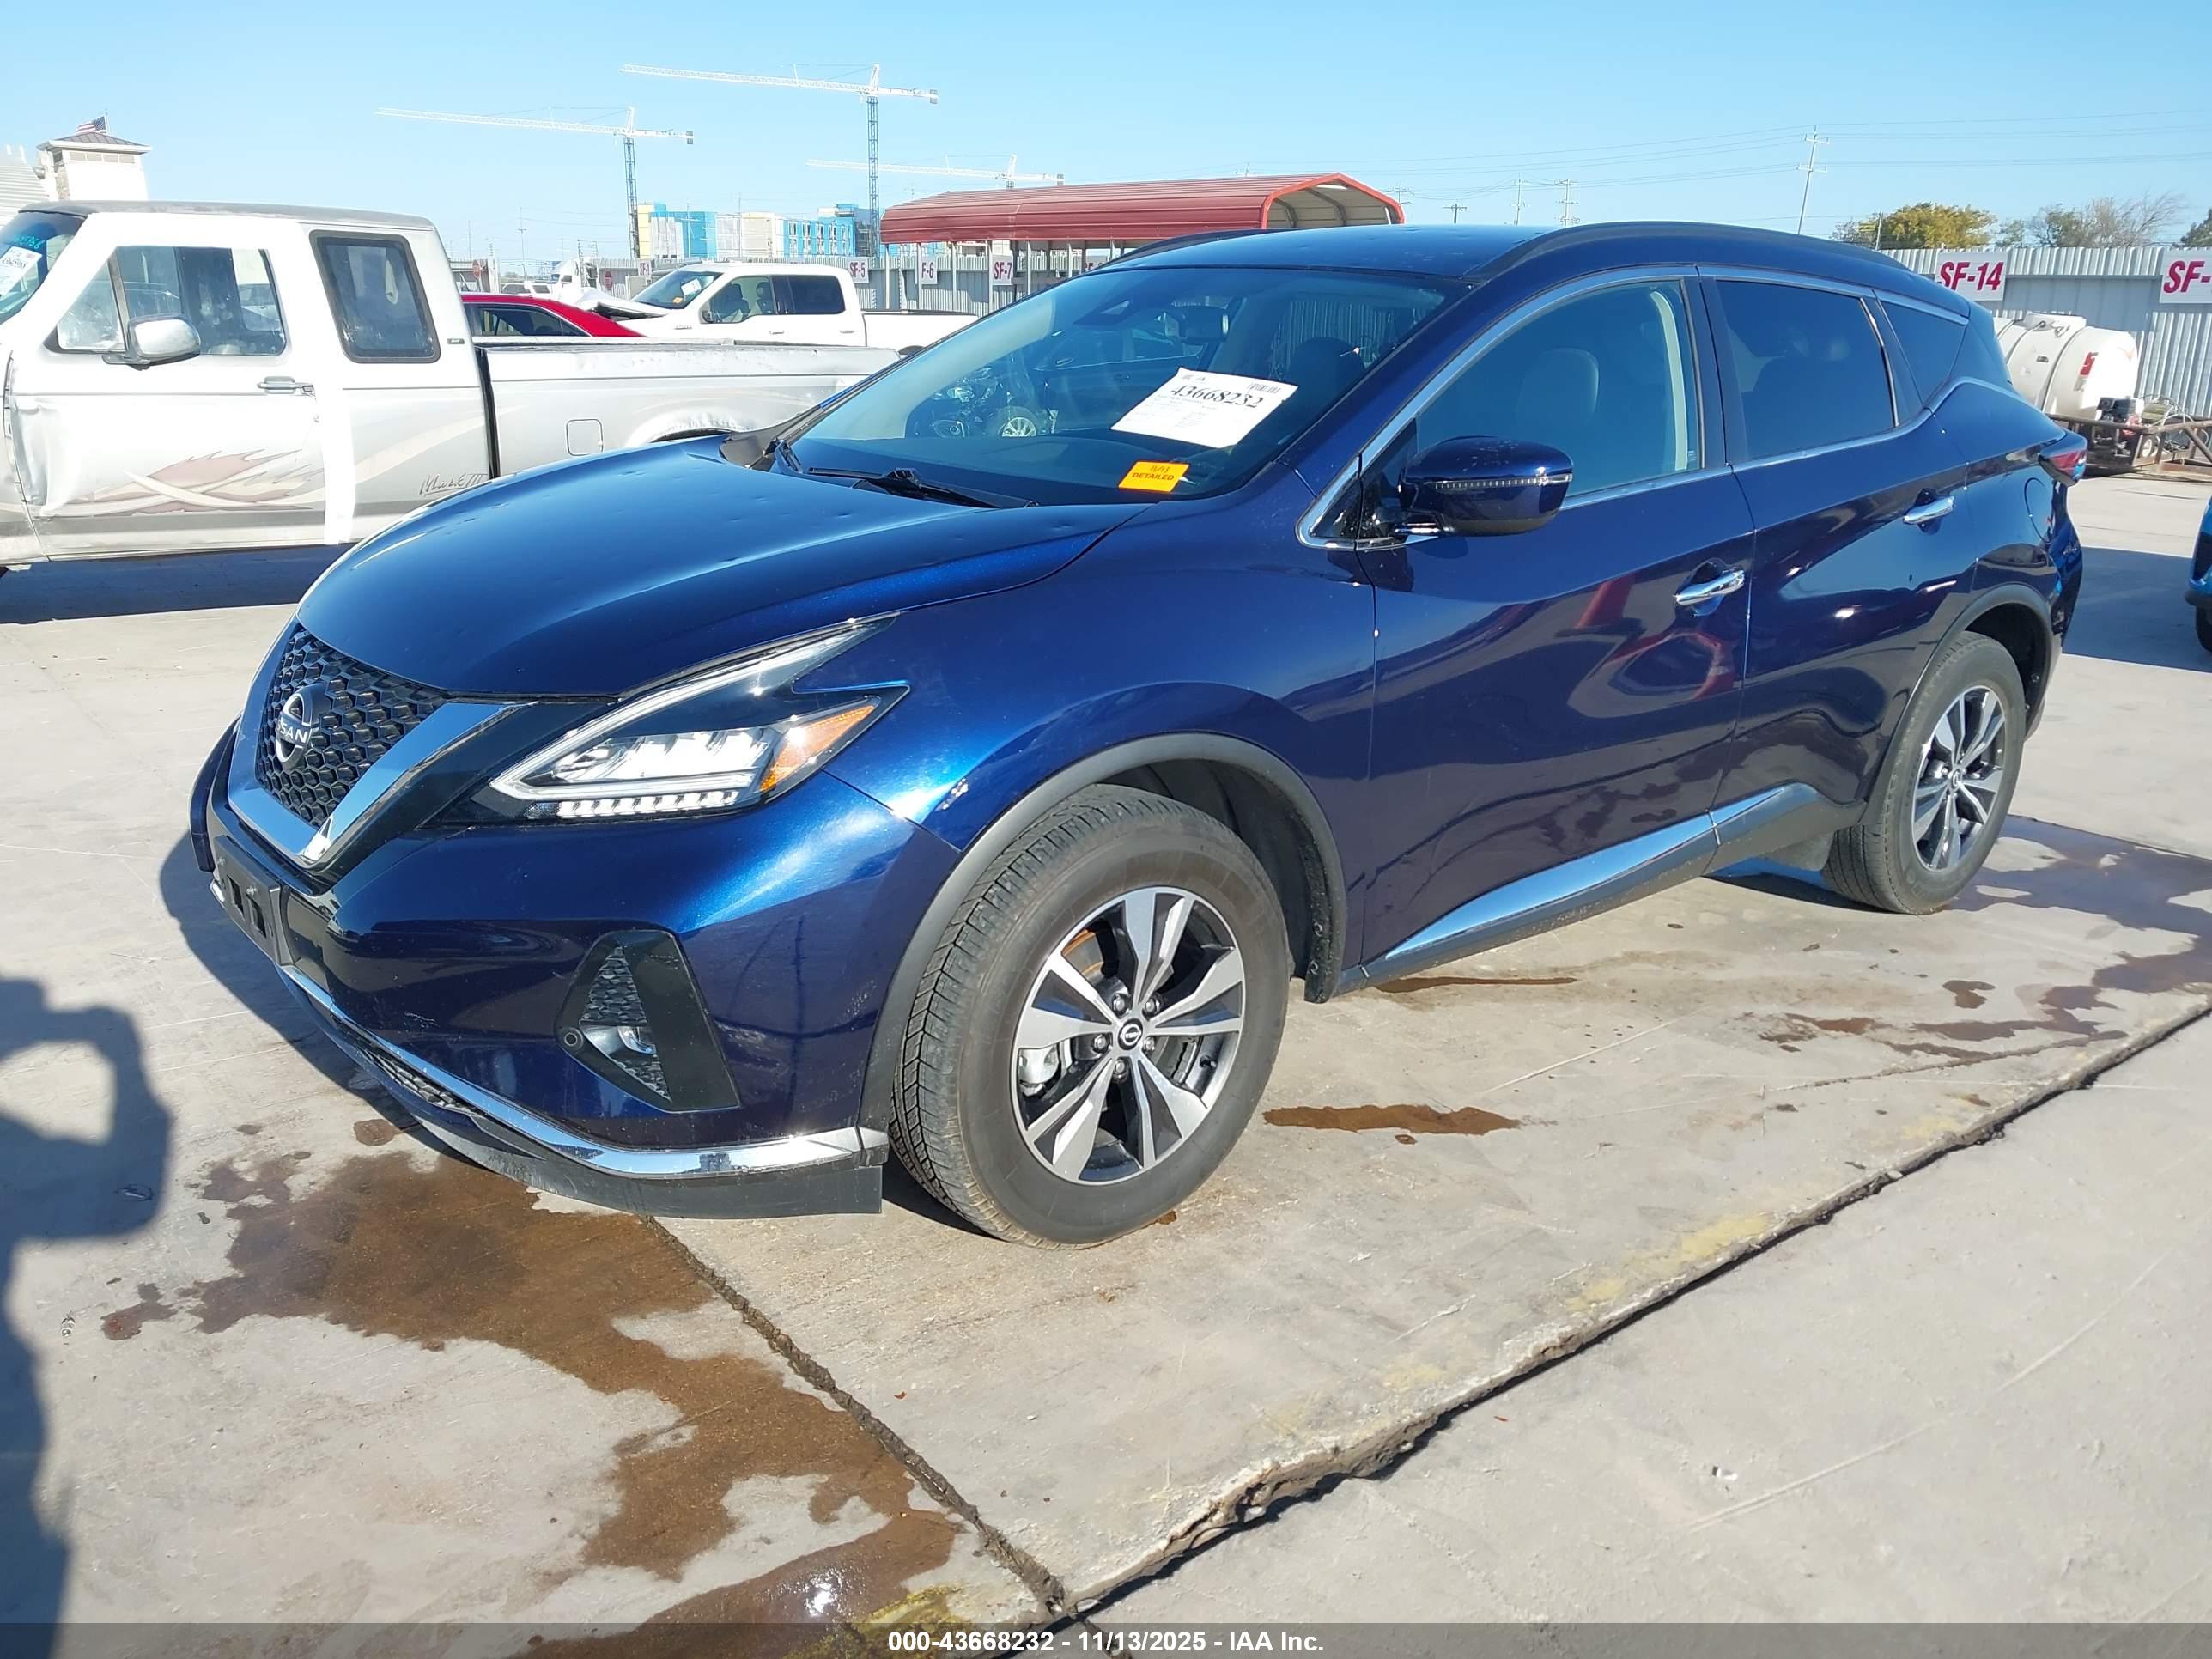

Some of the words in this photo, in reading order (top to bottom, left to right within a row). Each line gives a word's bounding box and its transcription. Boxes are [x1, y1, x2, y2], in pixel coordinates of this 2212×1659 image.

[849, 262, 866, 278] SF-5
[921, 262, 934, 279] F-6
[994, 261, 1012, 280] SF-7
[1939, 261, 2004, 291] SF-14
[2163, 260, 2212, 294] SF-
[1170, 385, 1265, 409] 43668232
[1132, 472, 1175, 481] DETAILED
